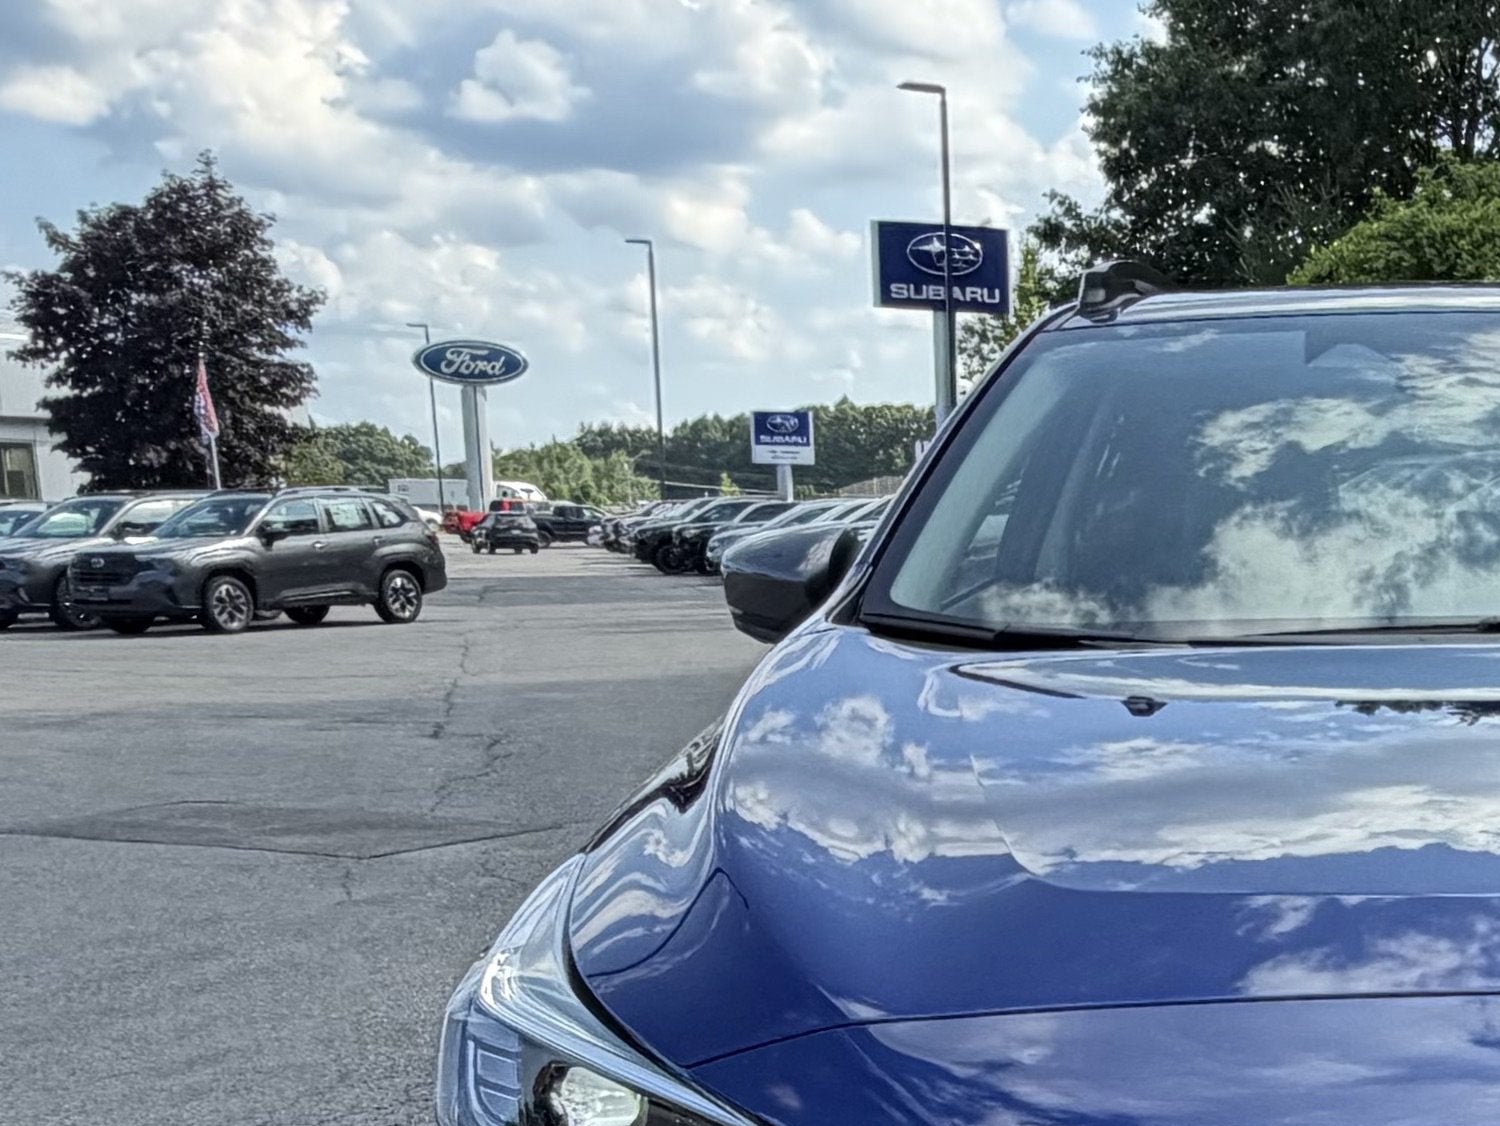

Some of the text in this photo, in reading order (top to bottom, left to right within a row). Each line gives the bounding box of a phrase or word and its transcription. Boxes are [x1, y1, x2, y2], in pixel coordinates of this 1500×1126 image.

[889, 283, 1000, 304] SUBARU
[440, 347, 506, 376] Ford
[759, 434, 807, 444] SUBARU
